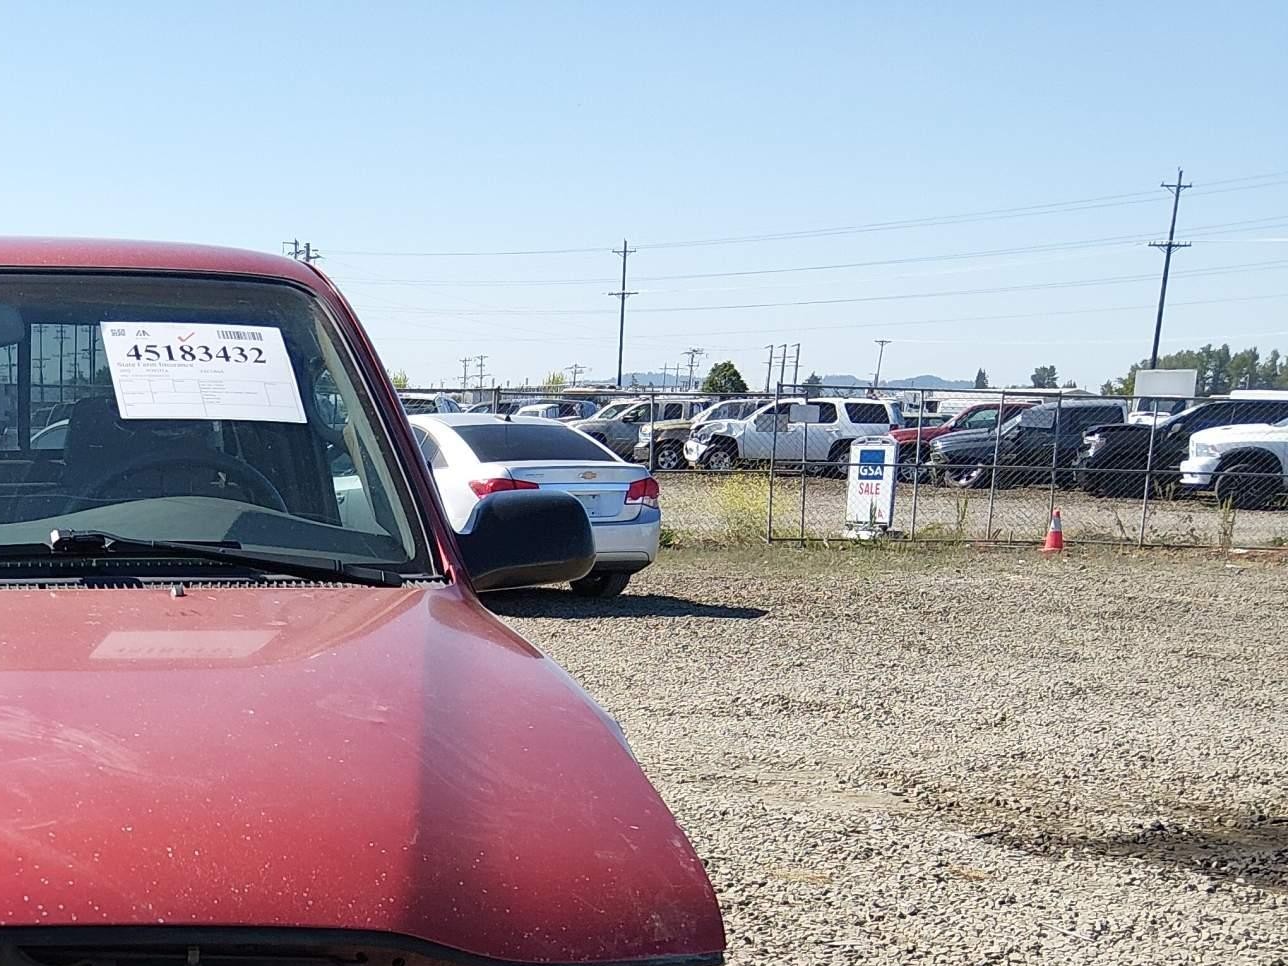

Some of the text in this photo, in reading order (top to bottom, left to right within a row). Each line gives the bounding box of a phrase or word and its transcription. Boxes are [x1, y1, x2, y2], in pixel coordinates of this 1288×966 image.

[126, 344, 267, 364] 45183432
[859, 465, 883, 476] GSA
[858, 482, 881, 495] SALE
